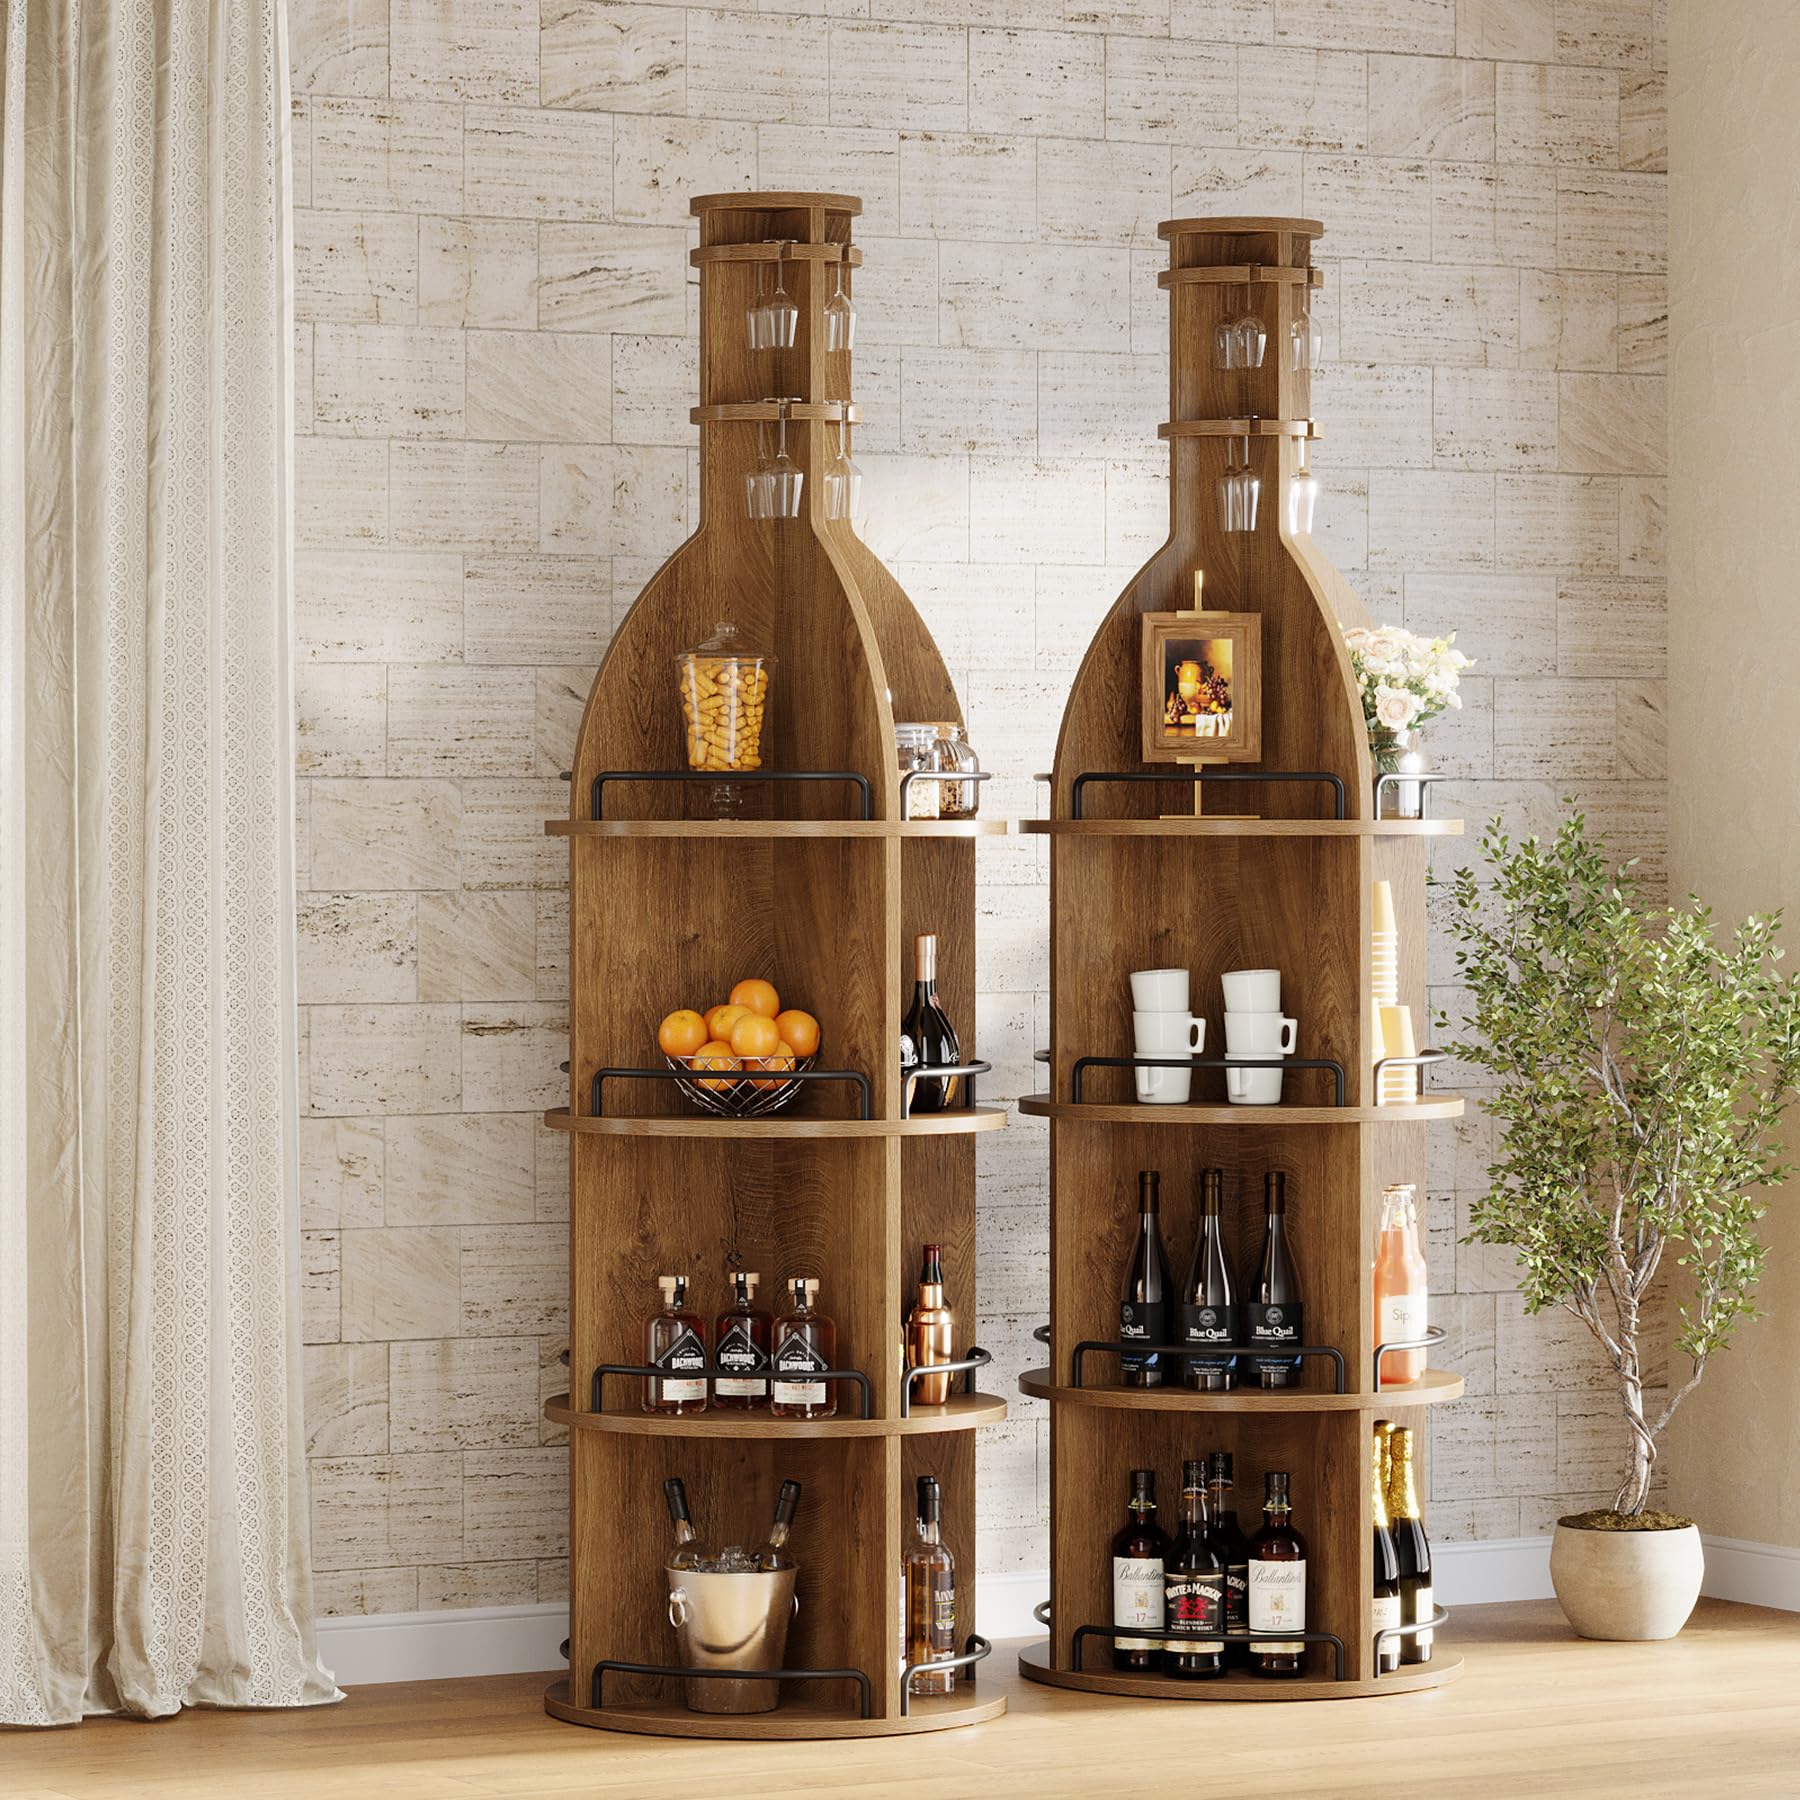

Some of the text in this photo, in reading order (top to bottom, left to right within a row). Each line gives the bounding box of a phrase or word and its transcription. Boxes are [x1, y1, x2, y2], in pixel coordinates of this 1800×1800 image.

[1125, 1324, 1144, 1336] Quail
[1189, 1327, 1205, 1337] Blue
[1205, 1328, 1228, 1340] Quail
[1256, 1326, 1272, 1335] Blue
[1272, 1326, 1294, 1338] Quail
[720, 1352, 755, 1366] BACKWOODS
[779, 1360, 815, 1372] BACKWOODS
[1227, 1575, 1247, 1591] ACKAY
[1192, 1582, 1223, 1602] MACKAY
[1136, 1612, 1147, 1623] 17
[1271, 1615, 1282, 1626] 17
